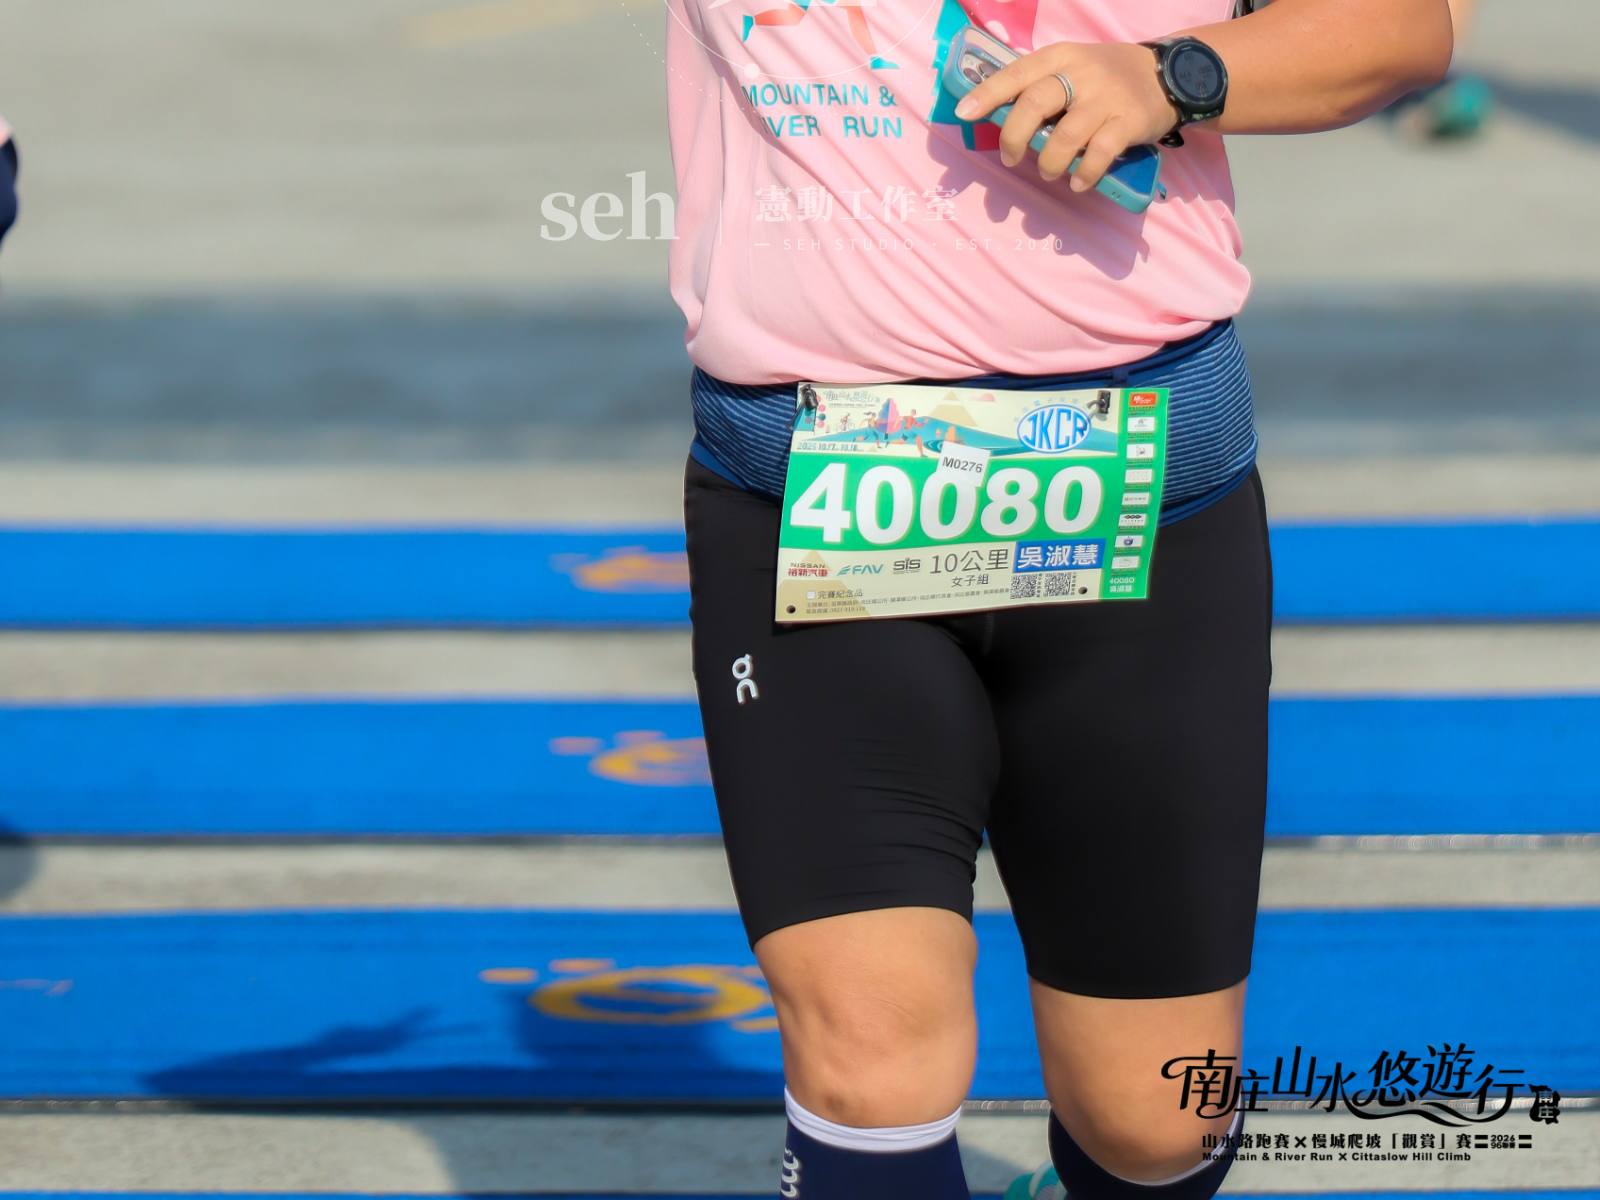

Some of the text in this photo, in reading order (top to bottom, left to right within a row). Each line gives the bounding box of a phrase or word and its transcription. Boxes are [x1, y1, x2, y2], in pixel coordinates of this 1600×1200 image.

[878, 85, 898, 107] &
[842, 116, 902, 138] RUN
[1021, 406, 1089, 450] JKCR
[943, 456, 983, 473] M0276
[790, 462, 1104, 545] 40080
[930, 544, 1099, 575] 10公里 吳淑慧
[951, 573, 989, 587] 女子組
